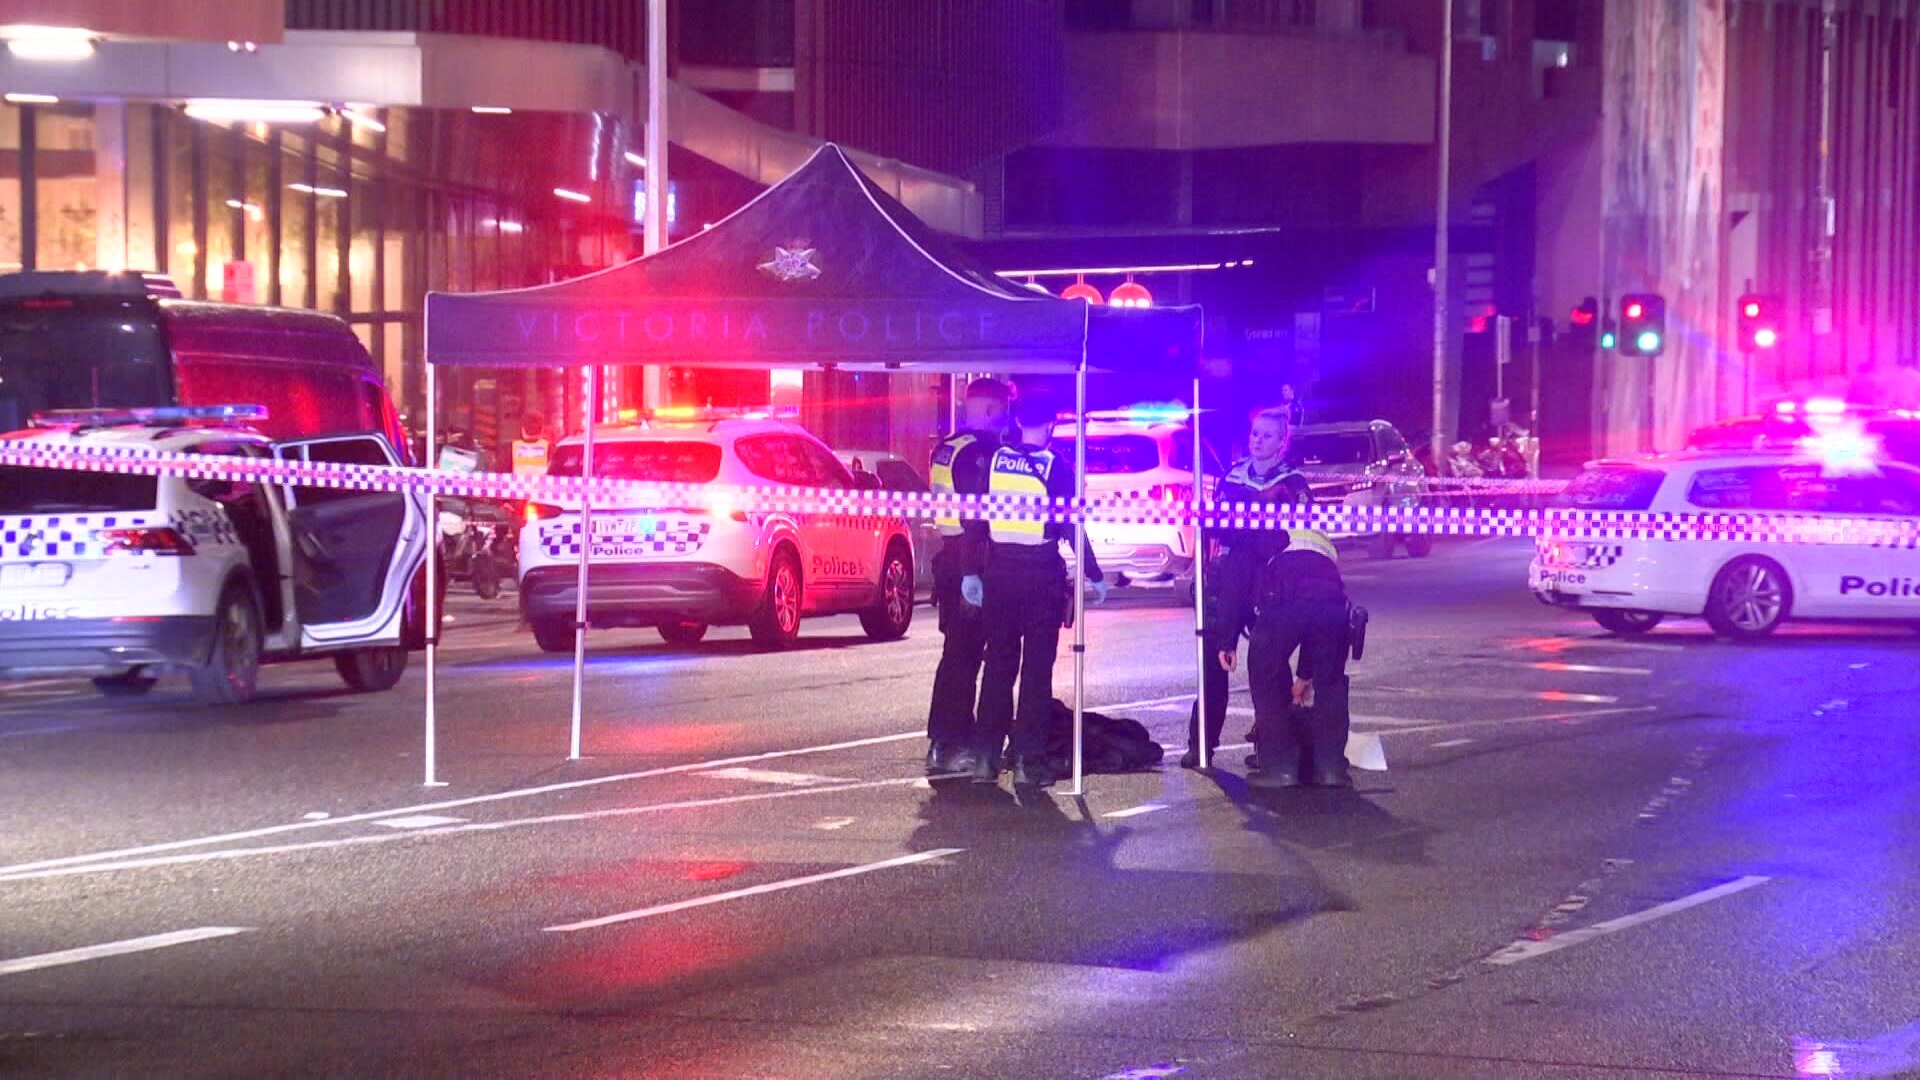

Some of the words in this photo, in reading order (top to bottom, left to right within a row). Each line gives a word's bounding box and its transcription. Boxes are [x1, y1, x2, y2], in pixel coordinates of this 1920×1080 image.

[515, 311, 769, 342] VICTORIA
[807, 310, 993, 342] POLICE
[593, 545, 644, 556] Police
[812, 556, 858, 576] Police
[1540, 569, 1586, 584] Police
